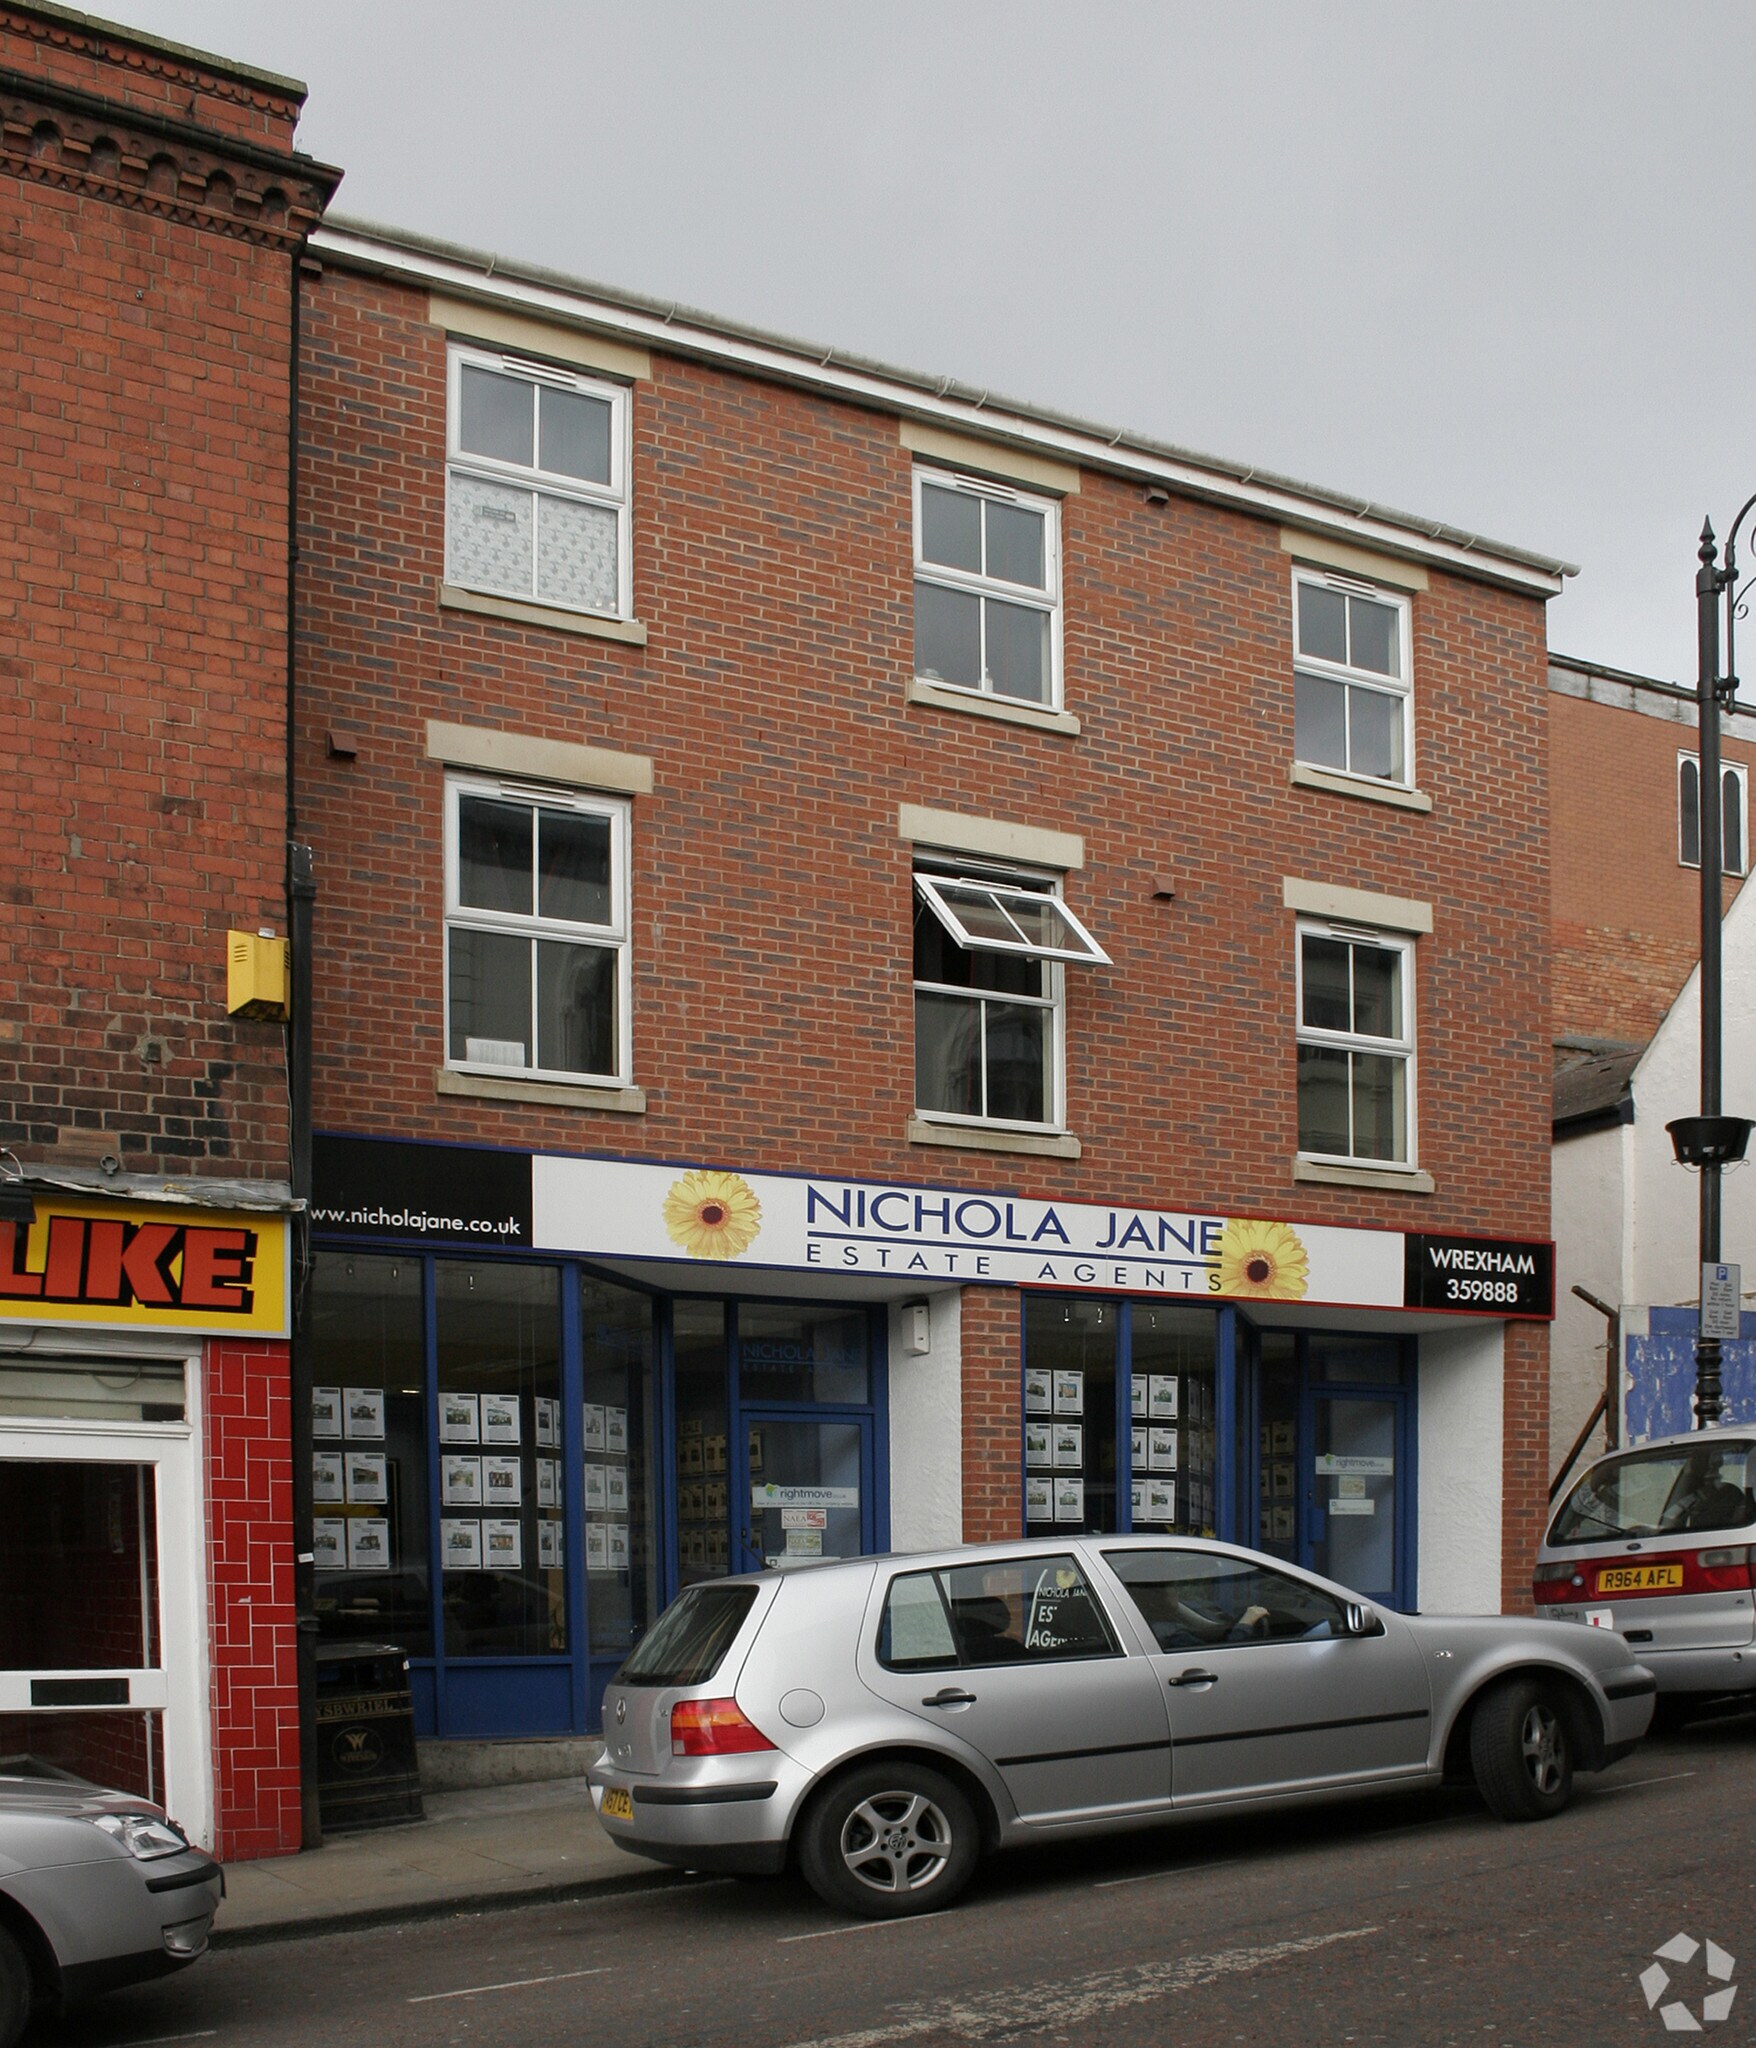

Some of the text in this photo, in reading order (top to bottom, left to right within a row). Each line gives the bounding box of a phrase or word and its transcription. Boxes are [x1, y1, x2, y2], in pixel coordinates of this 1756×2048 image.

[311, 1207, 520, 1235] ww.nicholajane.co.uk
[806, 1184, 1223, 1256] NICHOLA JANE
[0, 1215, 257, 1313] LIKE
[807, 1243, 1222, 1291] ESTATE AGENTS
[1429, 1247, 1535, 1274] WREXHAM
[1718, 1267, 1726, 1279] P
[1447, 1278, 1518, 1303] 359888
[743, 1343, 815, 1360] NICHOLA
[1605, 1569, 1676, 1588] R964 AFL
[1039, 1587, 1069, 1598] NICHOLA
[1038, 1605, 1058, 1623] ES
